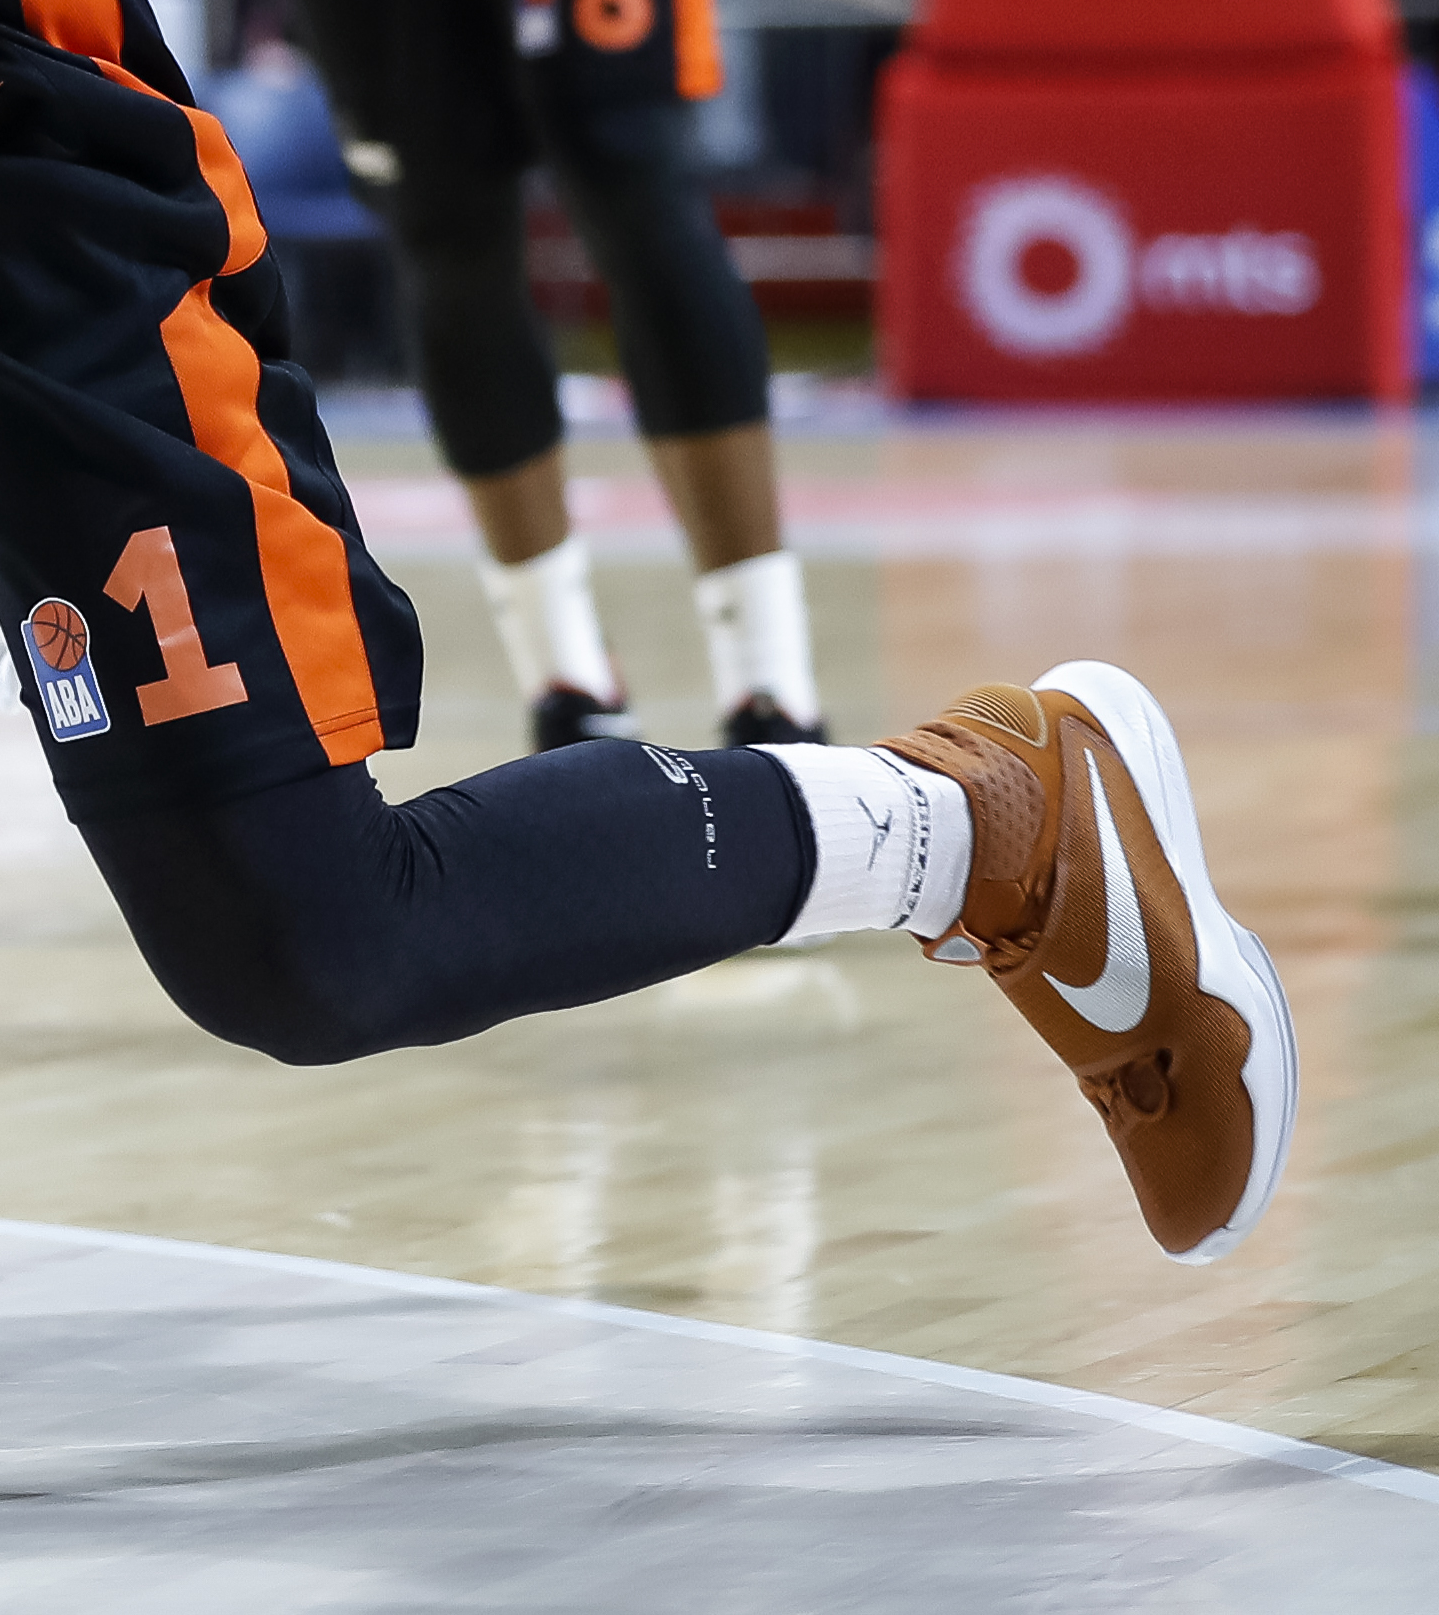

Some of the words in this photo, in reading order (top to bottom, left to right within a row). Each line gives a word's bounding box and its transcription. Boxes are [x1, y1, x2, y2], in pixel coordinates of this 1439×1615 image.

[1142, 232, 1318, 310] mts
[103, 525, 249, 727] 1
[46, 674, 101, 731] ABA
